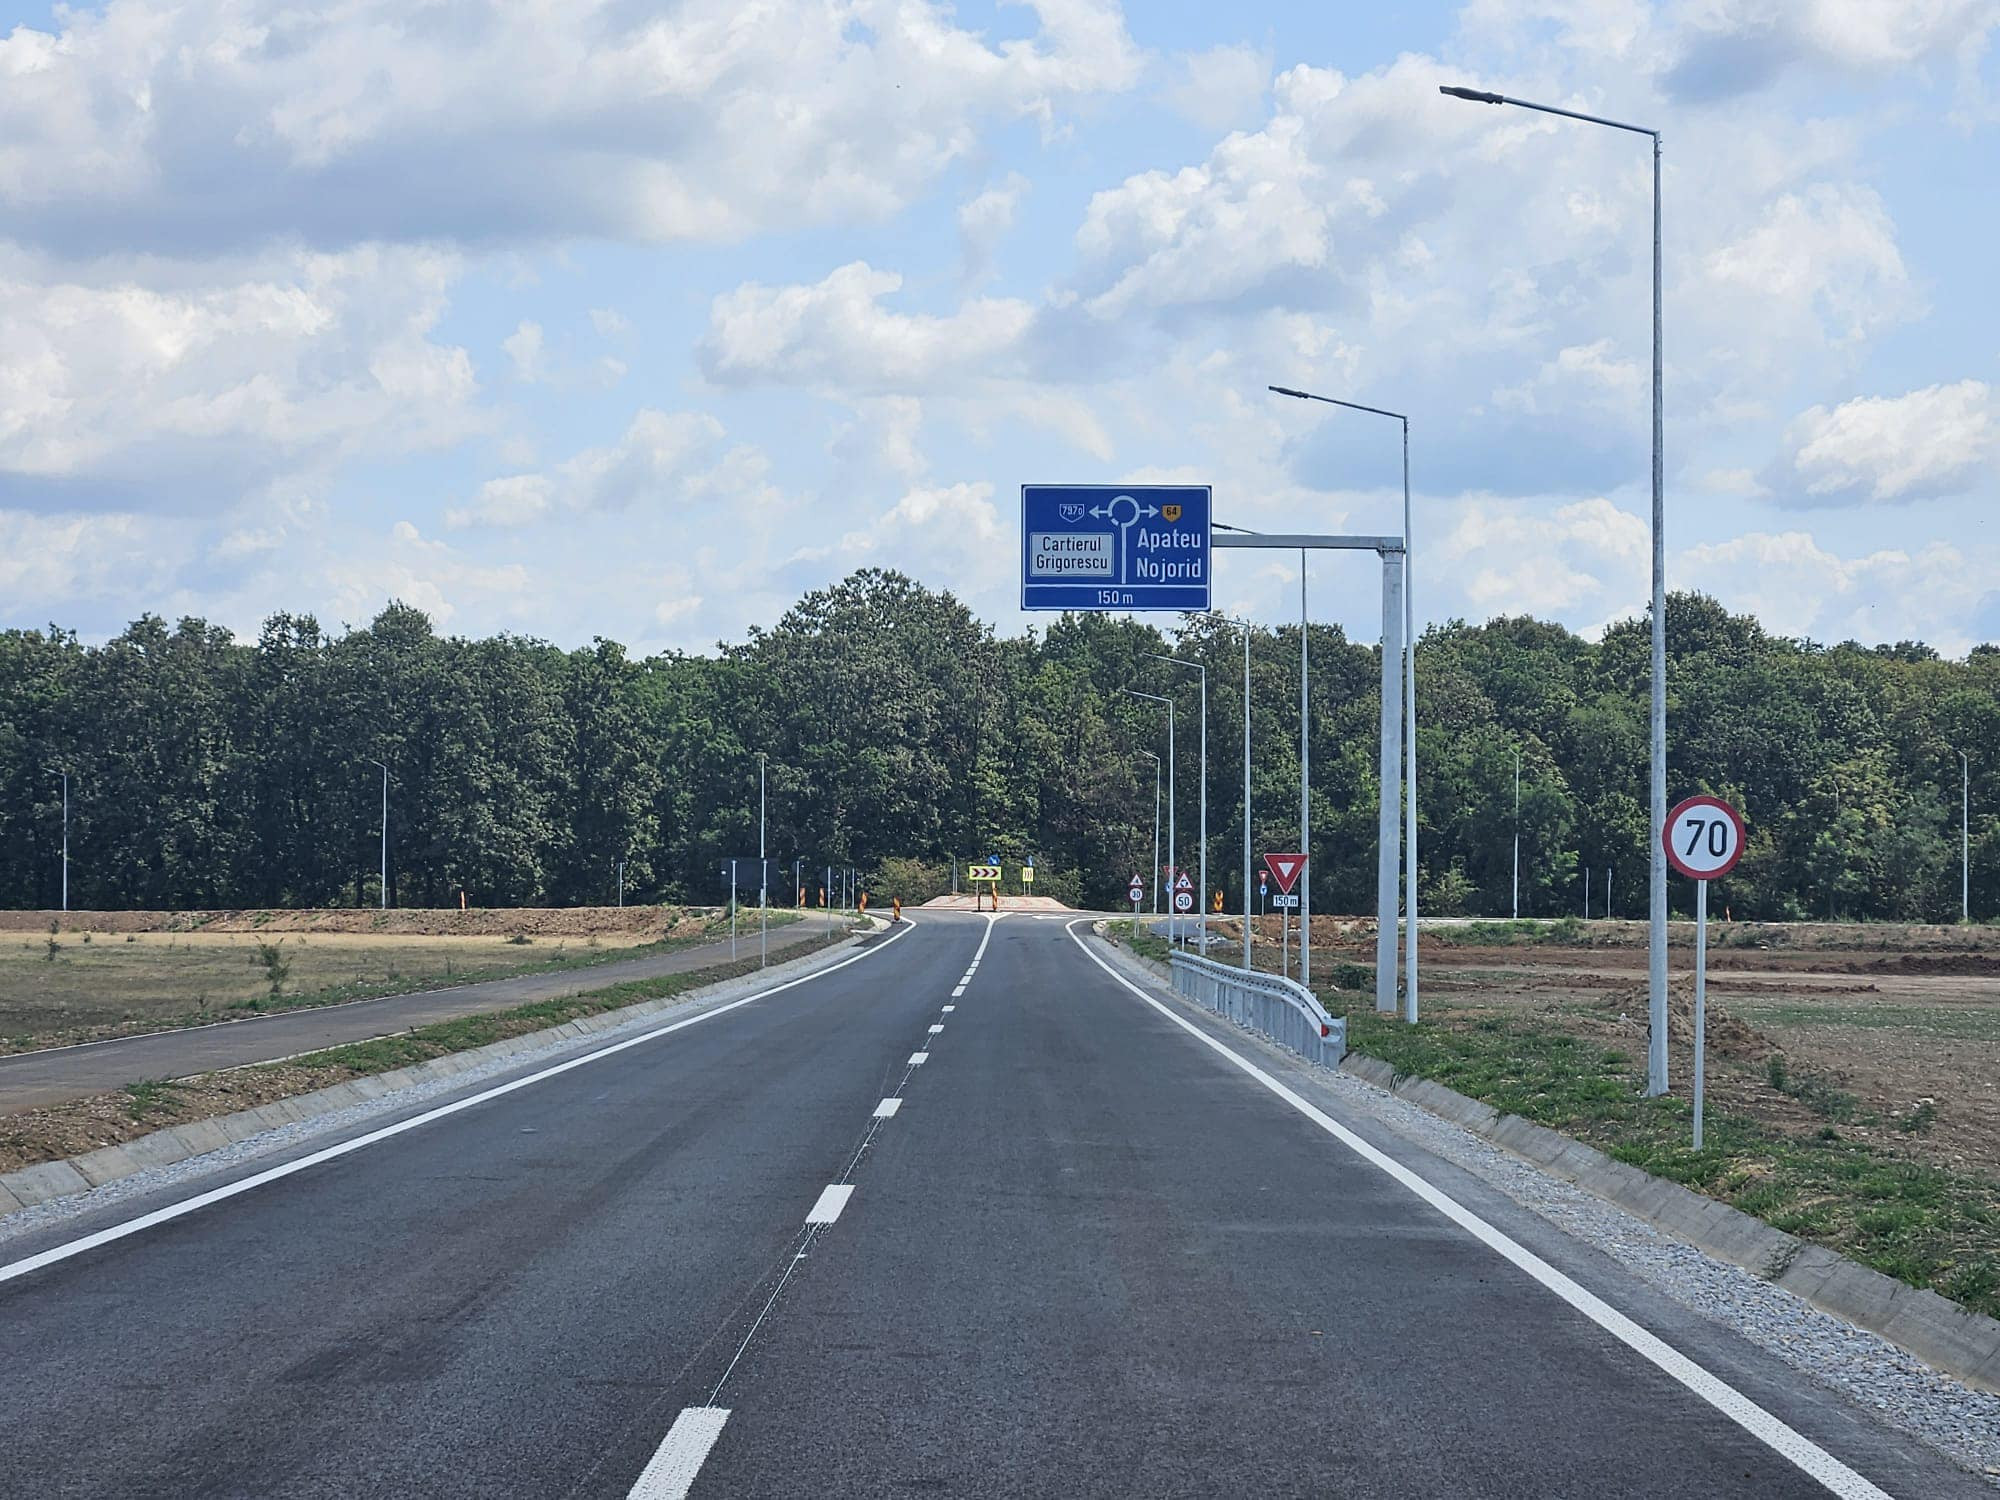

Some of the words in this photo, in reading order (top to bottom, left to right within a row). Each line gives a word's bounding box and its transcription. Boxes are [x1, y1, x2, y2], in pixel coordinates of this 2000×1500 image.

[1166, 506, 1177, 516] 64
[1042, 536, 1101, 552] Cartierul
[1137, 527, 1201, 553] Apateu
[1036, 554, 1108, 572] Grigorescu
[1136, 557, 1202, 583] Nojorid
[1098, 590, 1119, 604] 150
[1122, 593, 1133, 604] m
[1685, 819, 1728, 857] 70
[1178, 896, 1190, 906] 50
[1275, 896, 1289, 905] 150
